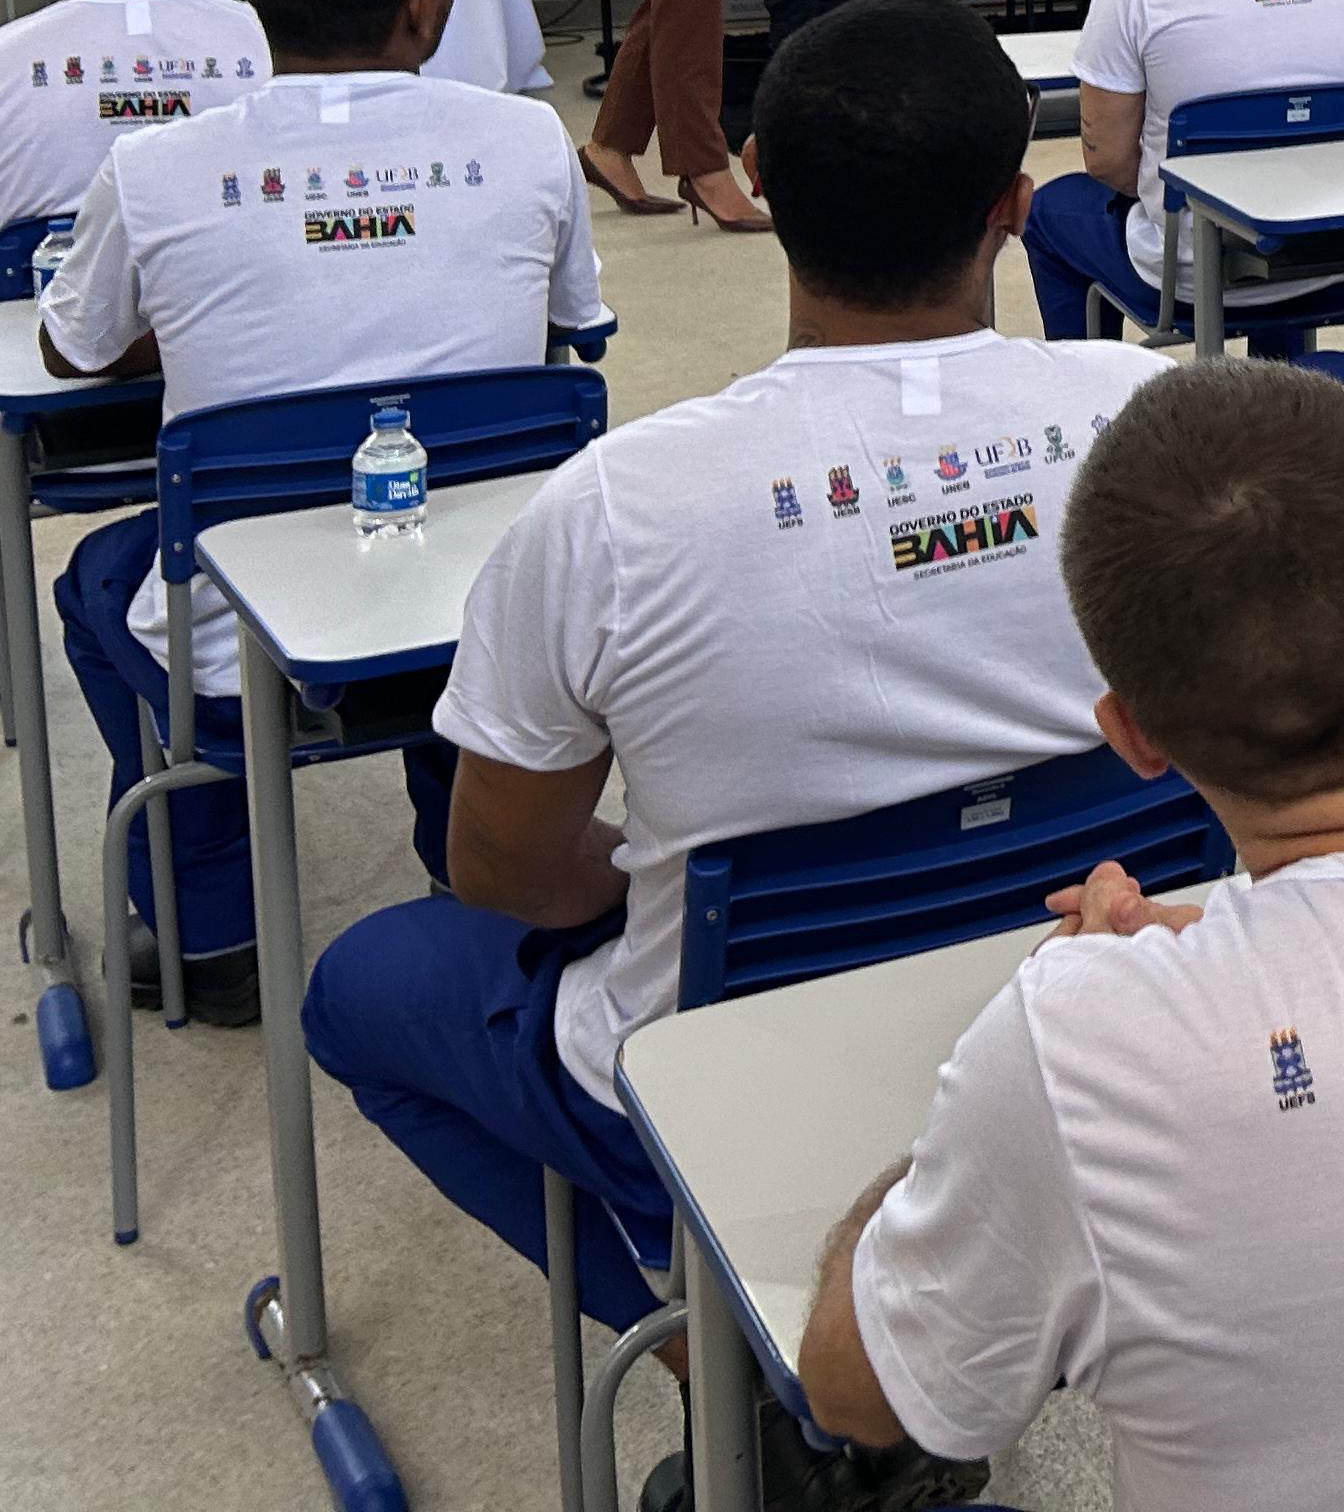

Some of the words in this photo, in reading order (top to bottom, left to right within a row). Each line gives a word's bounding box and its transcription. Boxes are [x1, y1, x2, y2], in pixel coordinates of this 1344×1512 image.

[100, 97, 192, 119] BAHIA
[304, 208, 356, 221] GOVERNO
[375, 203, 415, 215] ESTADO
[304, 215, 416, 244] BAHIA
[889, 508, 957, 536] GOVERNO
[959, 502, 980, 520] DO
[983, 493, 1034, 516] ESTADO
[891, 505, 1039, 571] BAHIA
